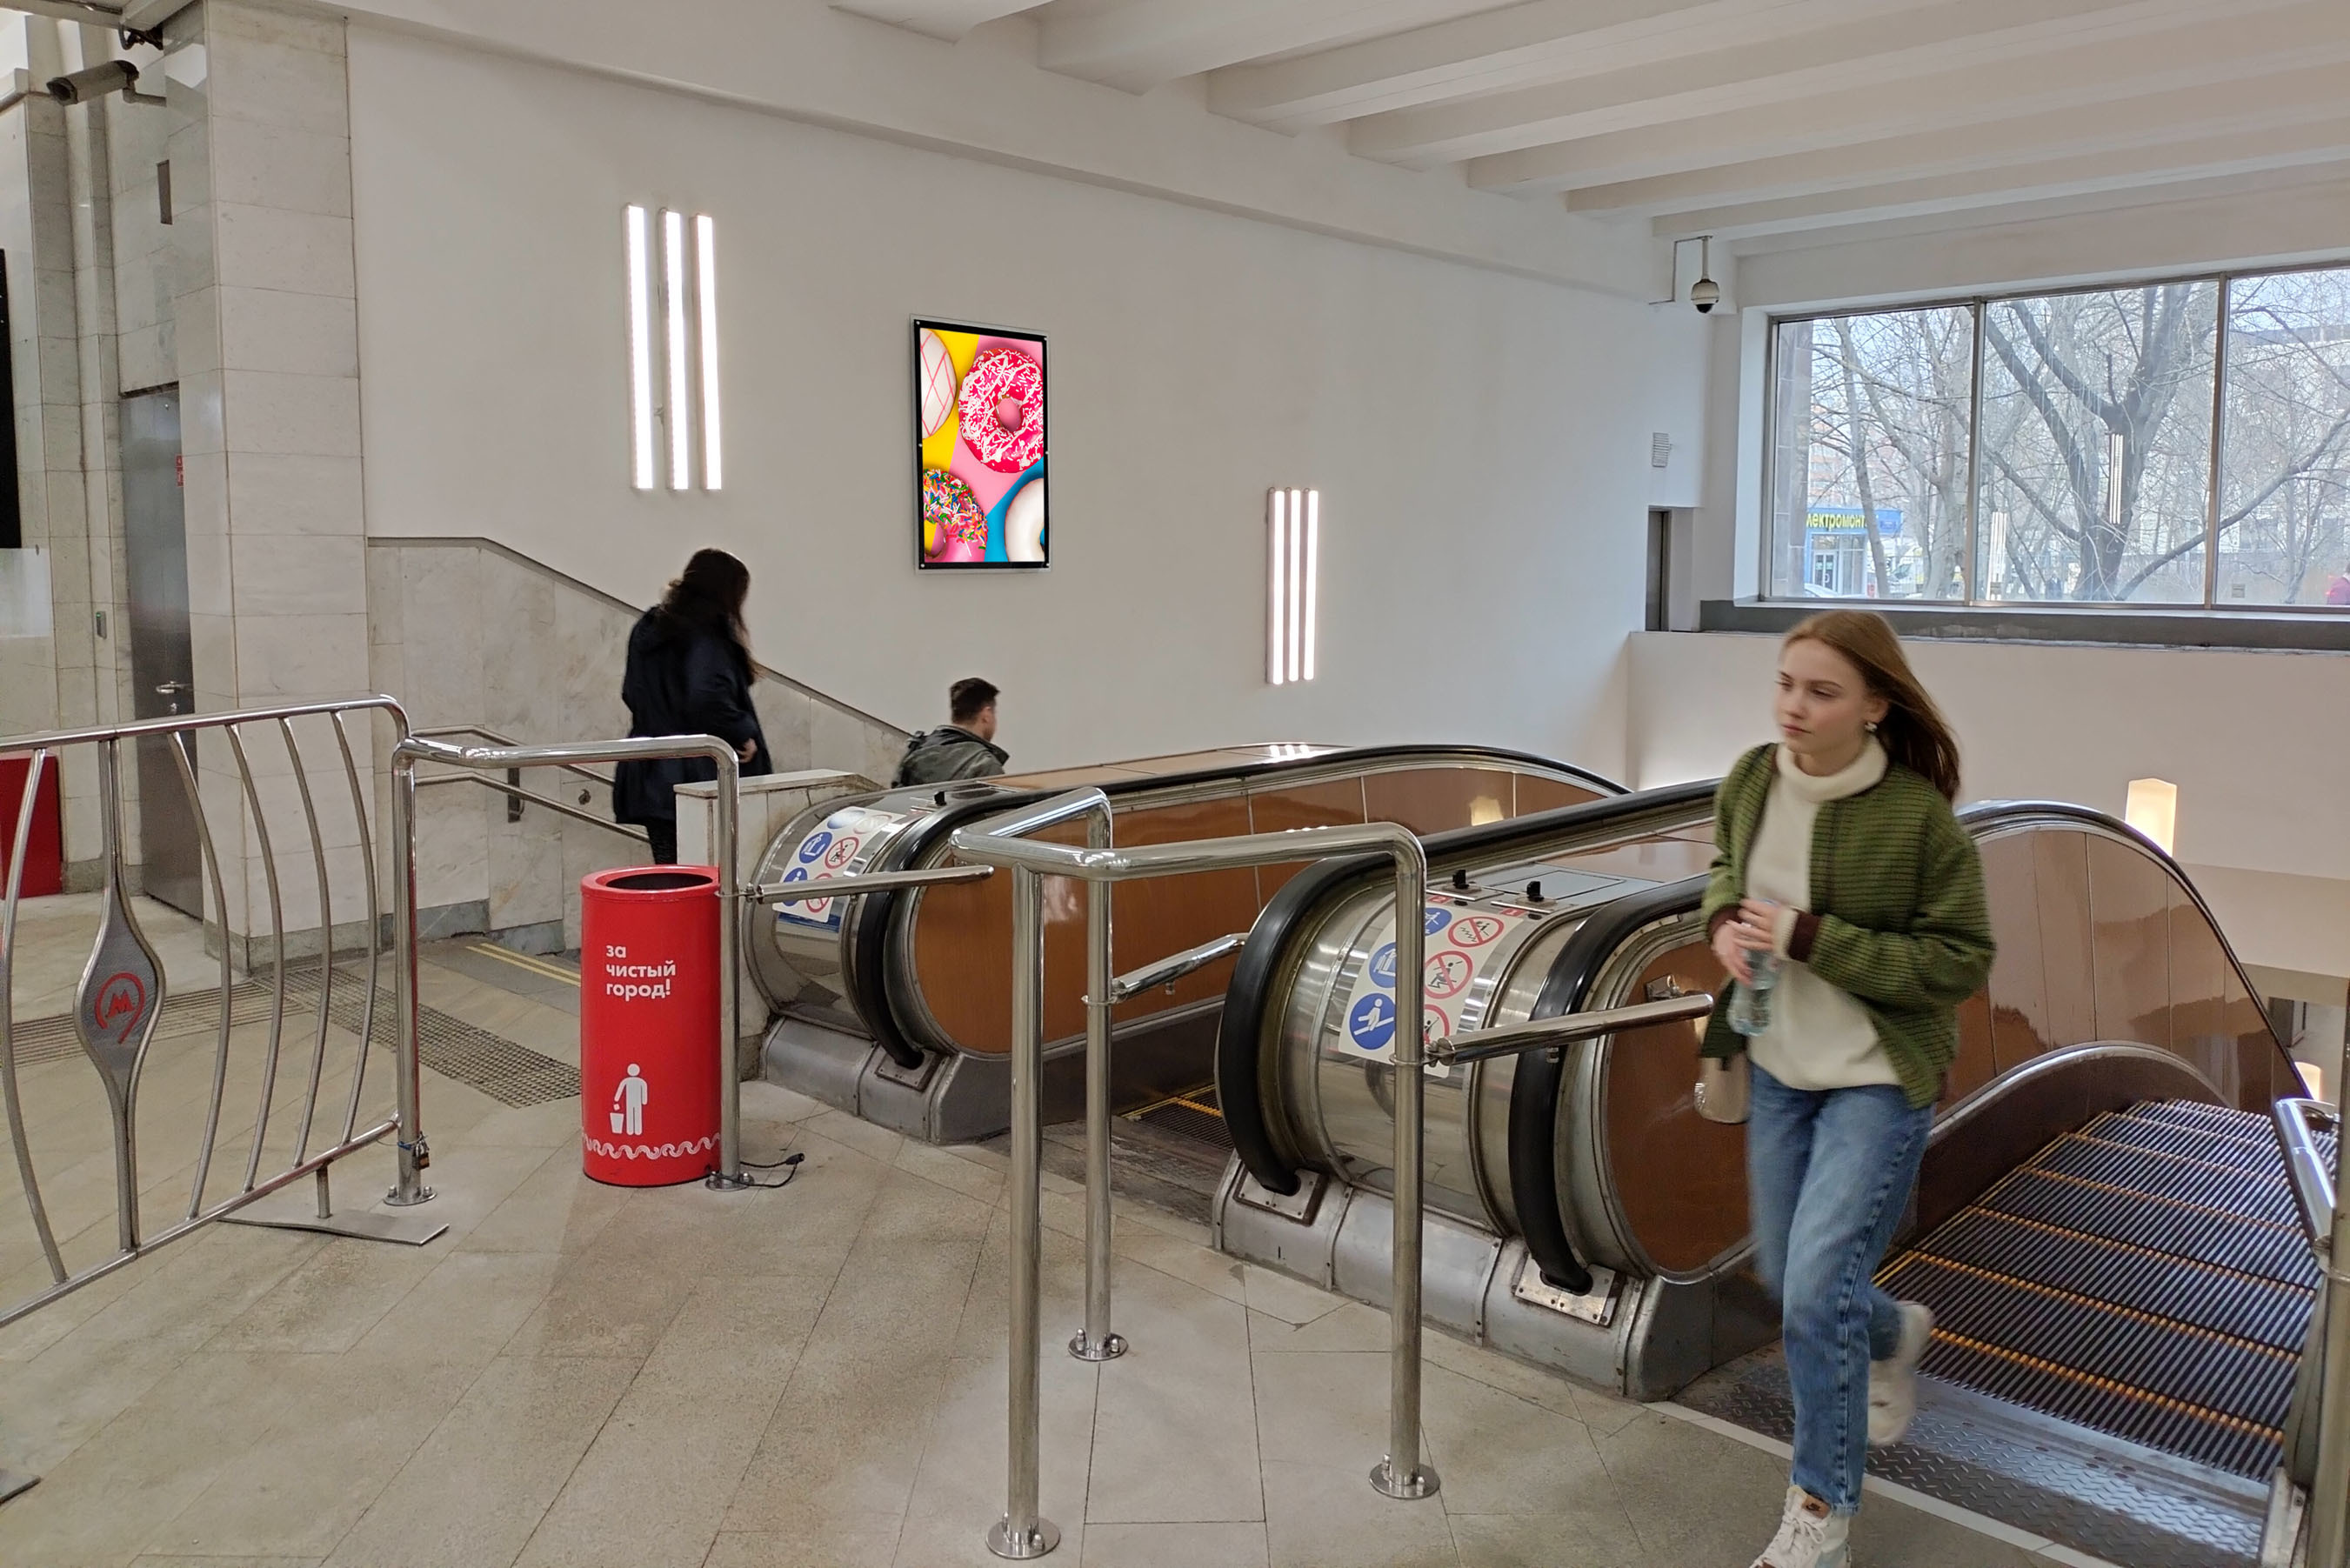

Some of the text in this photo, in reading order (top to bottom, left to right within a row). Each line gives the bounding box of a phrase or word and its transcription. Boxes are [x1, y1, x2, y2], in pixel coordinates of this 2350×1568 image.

[1806, 512, 1868, 531] лектромонт
[605, 944, 627, 958] за
[605, 959, 677, 977] чистый
[606, 978, 671, 1002] город!
